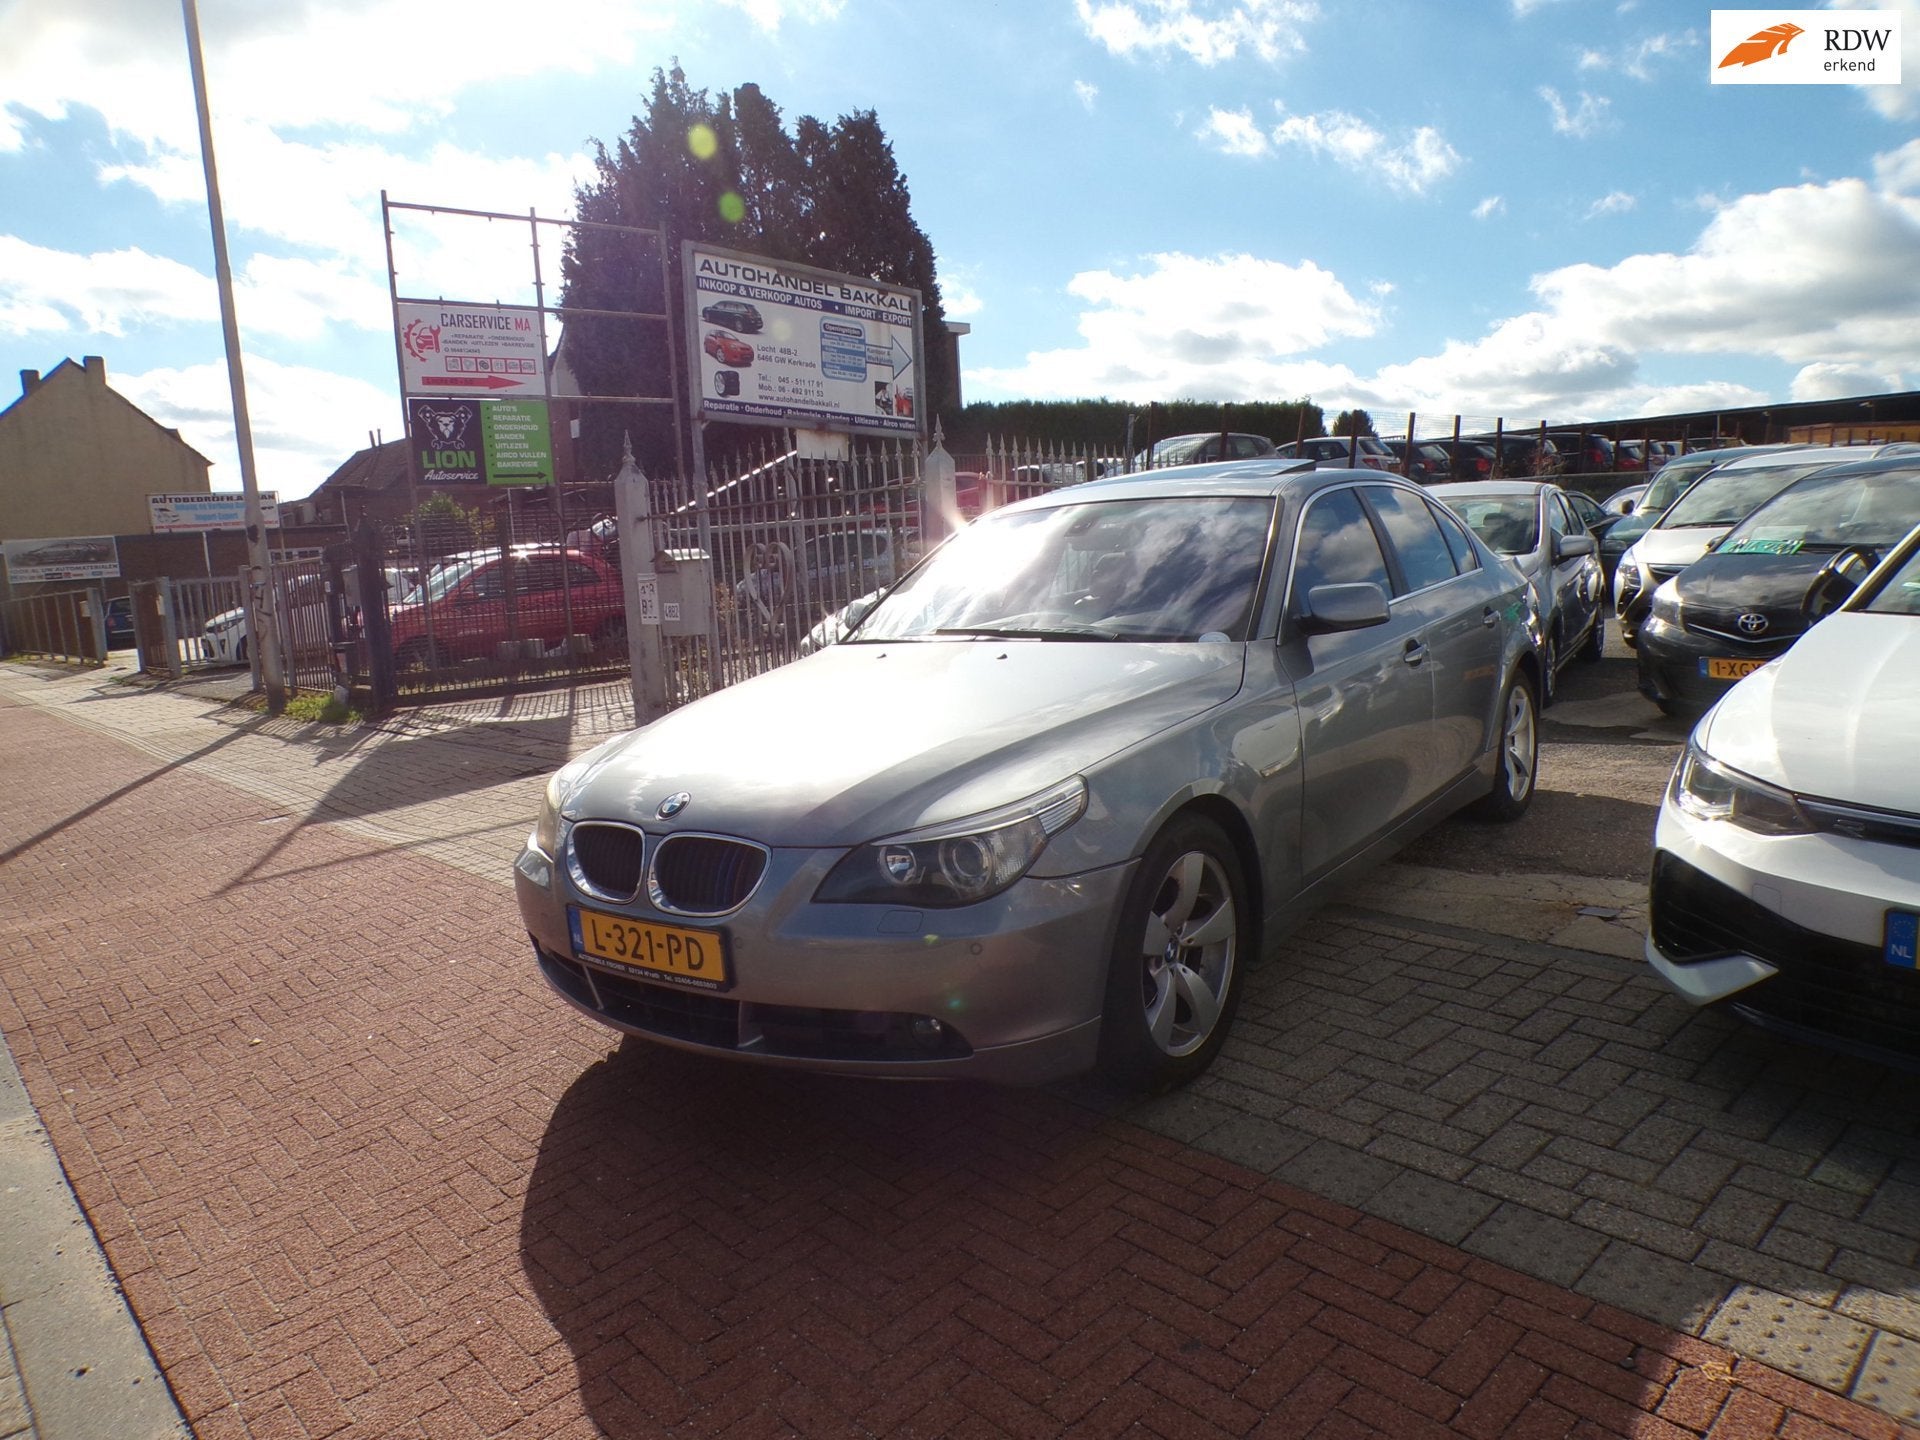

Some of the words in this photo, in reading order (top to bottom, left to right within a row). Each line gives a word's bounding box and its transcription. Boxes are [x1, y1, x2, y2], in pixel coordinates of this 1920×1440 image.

[700, 259, 834, 298] AUTOHANDEL
[840, 287, 913, 312] BAKKALI
[699, 278, 737, 293] INKOOP
[738, 286, 747, 296] &
[748, 287, 792, 304] VERKOOP
[794, 295, 823, 309] AUTOS
[845, 305, 876, 319] IMPORT
[882, 312, 912, 327] EXPORT
[440, 313, 512, 331] CARSERVICE
[514, 318, 531, 331] MA
[757, 344, 776, 354] Locht
[774, 356, 787, 365] GW
[703, 400, 739, 412] Reparatie
[744, 404, 783, 416] Onderhoud
[883, 419, 899, 428] Airco
[422, 450, 476, 469] LION
[424, 469, 479, 481] Autoservice
[591, 918, 705, 971] L-321-PD
[1890, 943, 1913, 959] NL
